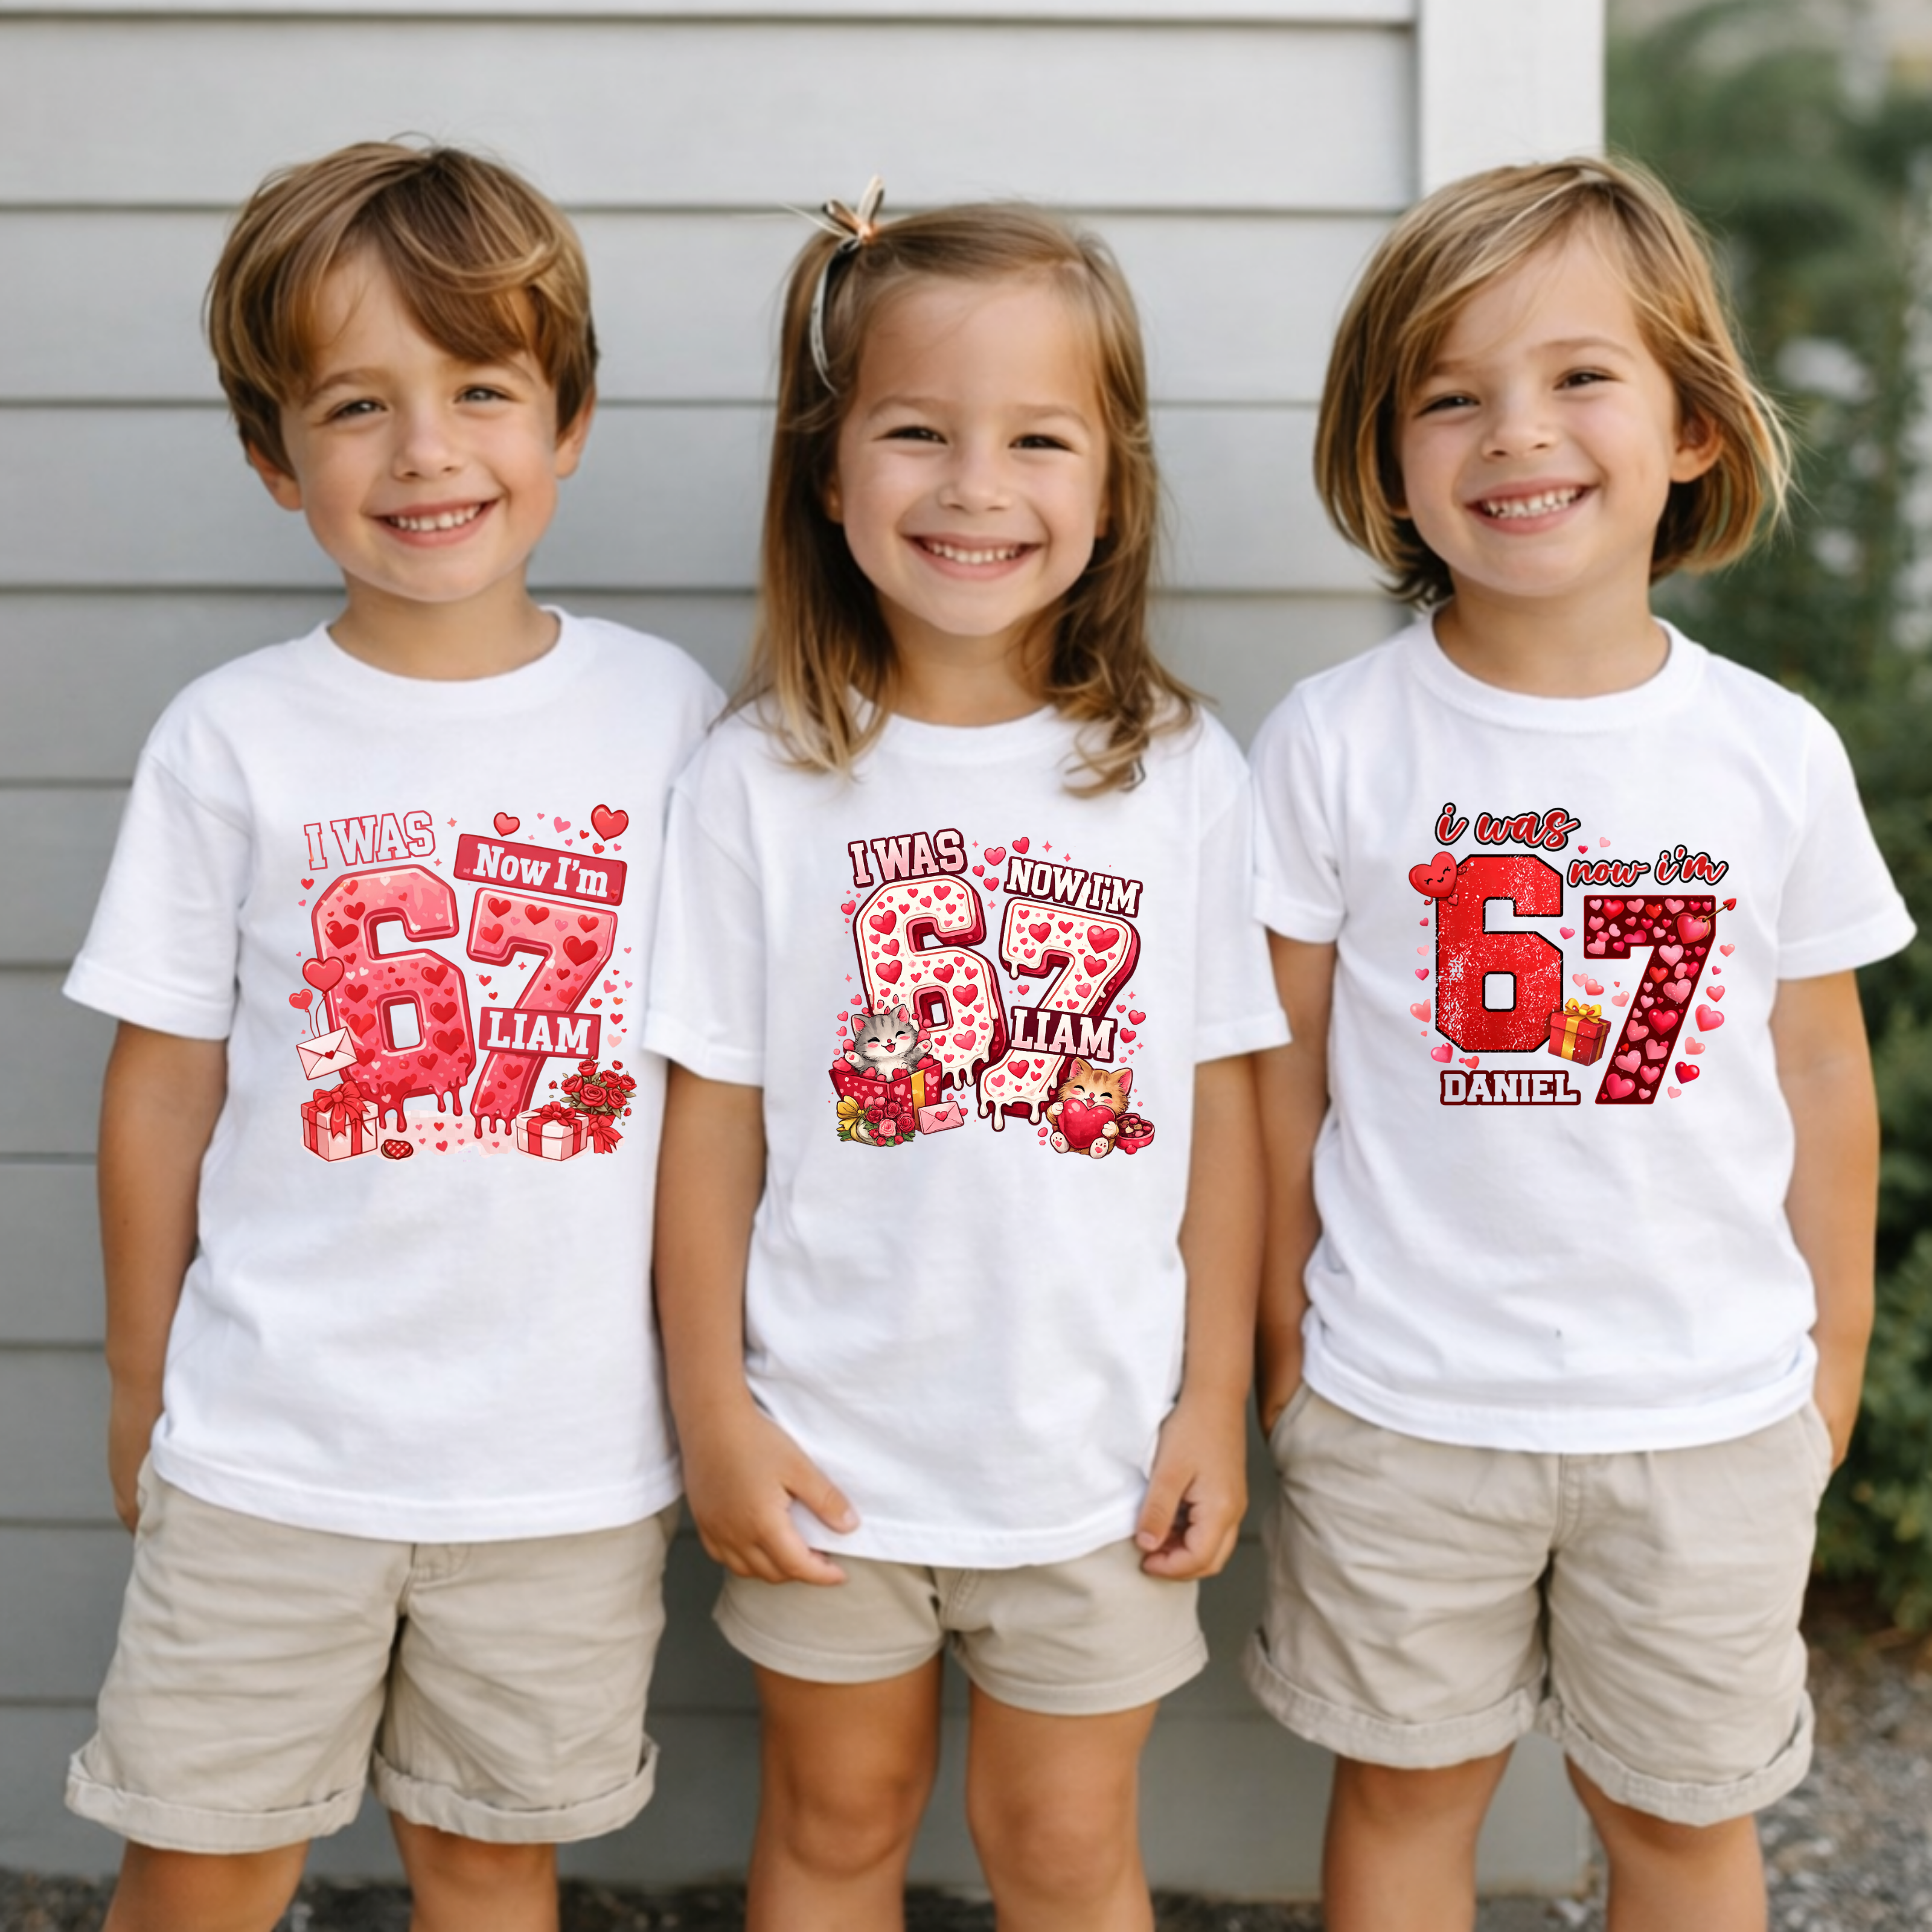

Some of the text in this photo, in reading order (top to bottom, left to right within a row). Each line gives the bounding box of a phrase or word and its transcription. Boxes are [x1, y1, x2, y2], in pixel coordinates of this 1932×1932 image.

[304, 810, 436, 870] I WAS
[1435, 802, 1581, 852] i was
[473, 843, 608, 897] Now I'm
[848, 828, 968, 888] I WAS
[1003, 856, 1090, 906] NOW
[1567, 845, 1729, 888] now i'm
[312, 864, 618, 1138] 6 7
[853, 875, 1140, 1131] 6 7
[1435, 854, 1716, 1104] 6 7
[487, 1011, 591, 1055] LIAM
[1009, 1006, 1118, 1063] LIAM
[1440, 1070, 1581, 1105] DANIEL
